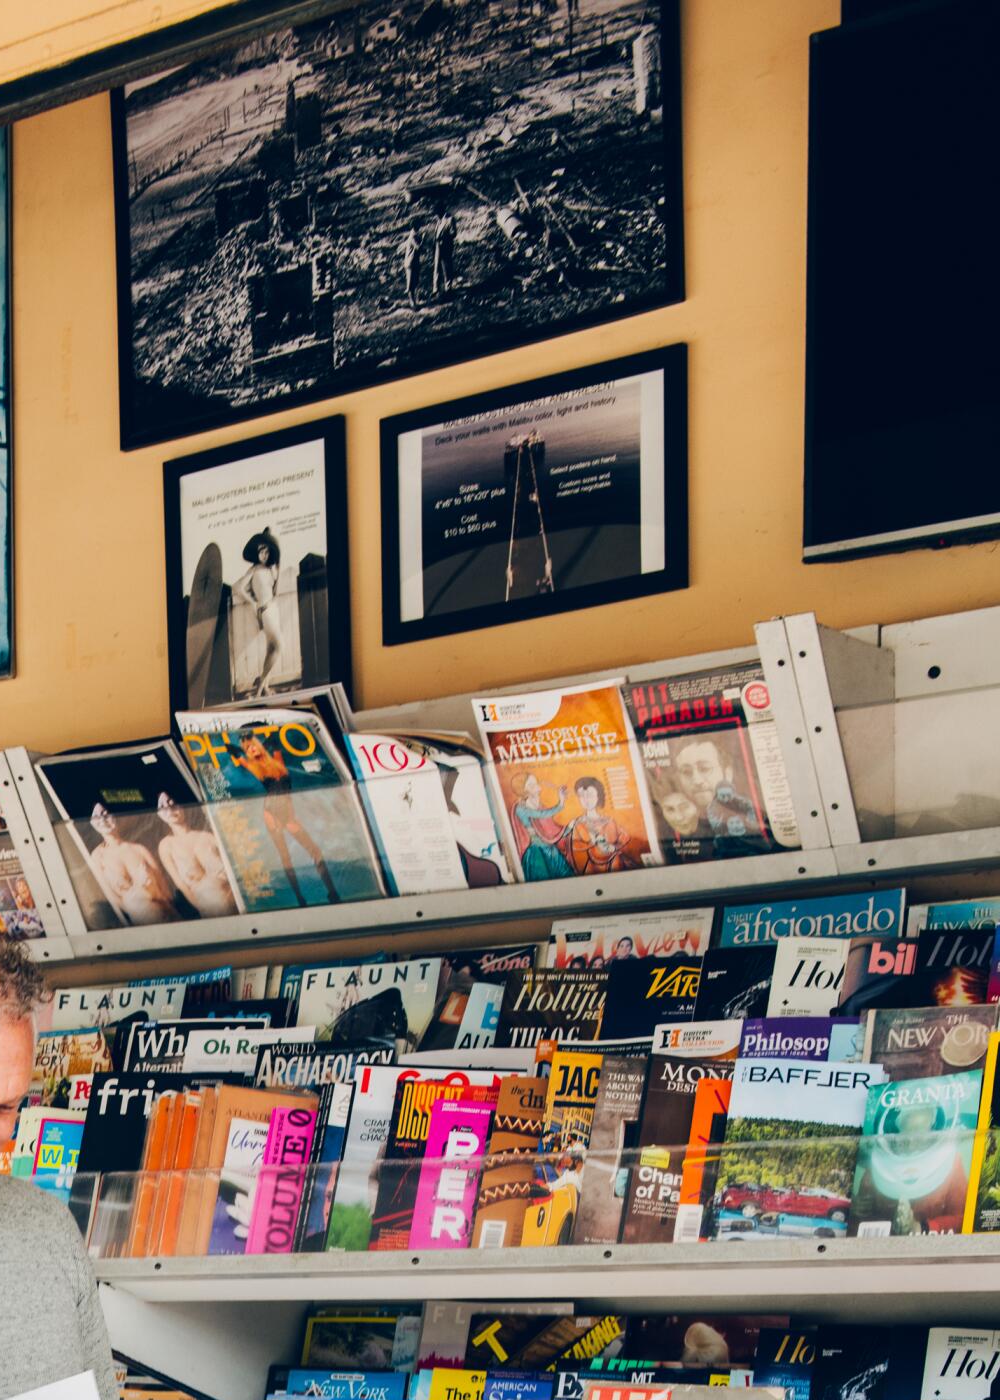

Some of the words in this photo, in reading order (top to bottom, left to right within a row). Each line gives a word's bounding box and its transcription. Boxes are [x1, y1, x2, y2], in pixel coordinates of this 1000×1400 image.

[575, 401, 589, 411] and
[632, 683, 668, 708] HIT
[507, 732, 533, 744] THE
[536, 725, 578, 740] STORY
[582, 722, 600, 736] OF
[496, 732, 620, 766] MEDICINE
[733, 896, 895, 945] aficionado
[307, 962, 431, 990] FLAUNT
[58, 988, 177, 1011] FLAUNT
[945, 1014, 970, 1025] THE
[204, 1039, 230, 1055] Oh
[887, 1026, 937, 1050] NEW
[272, 1044, 316, 1055] WORLD
[607, 1083, 636, 1091] ABOUT
[608, 1073, 626, 1081] THE
[749, 1065, 871, 1090] BAFFLER
[880, 1082, 966, 1109] GRANTA
[349, 1380, 389, 1400] YORK
[491, 1382, 537, 1393] AMERICAN
